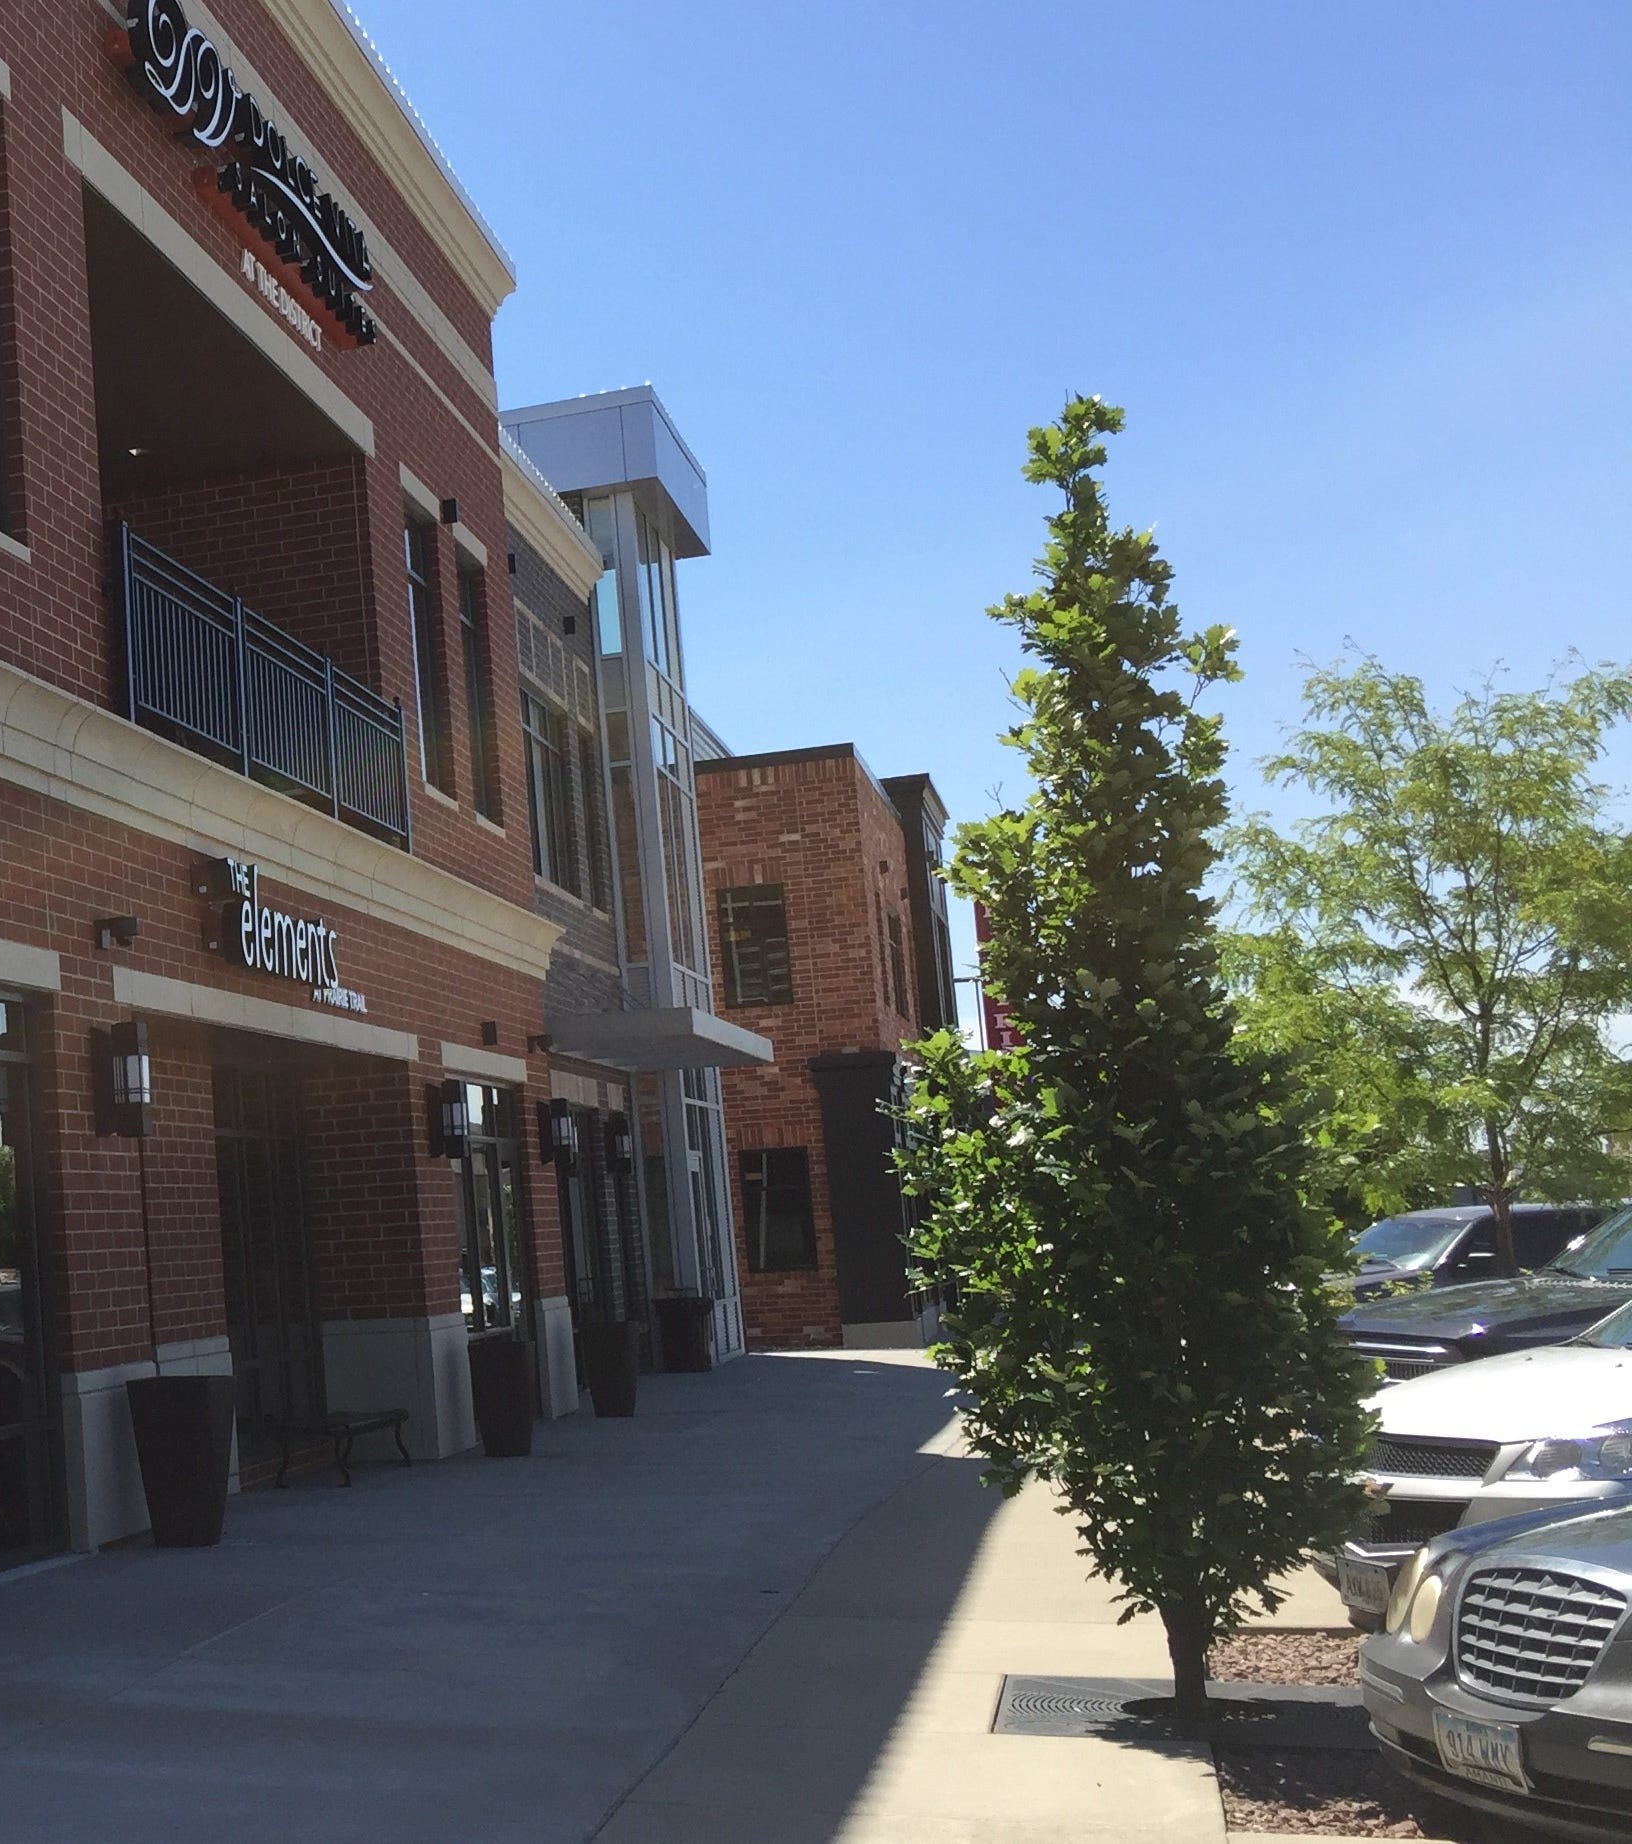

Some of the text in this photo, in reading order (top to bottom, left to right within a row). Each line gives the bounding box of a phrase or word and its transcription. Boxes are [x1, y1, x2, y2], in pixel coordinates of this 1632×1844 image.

[235, 161, 301, 257] SALON
[240, 248, 323, 352] AT THE DISTRICT
[227, 857, 252, 898] THE
[241, 864, 338, 989] elements
